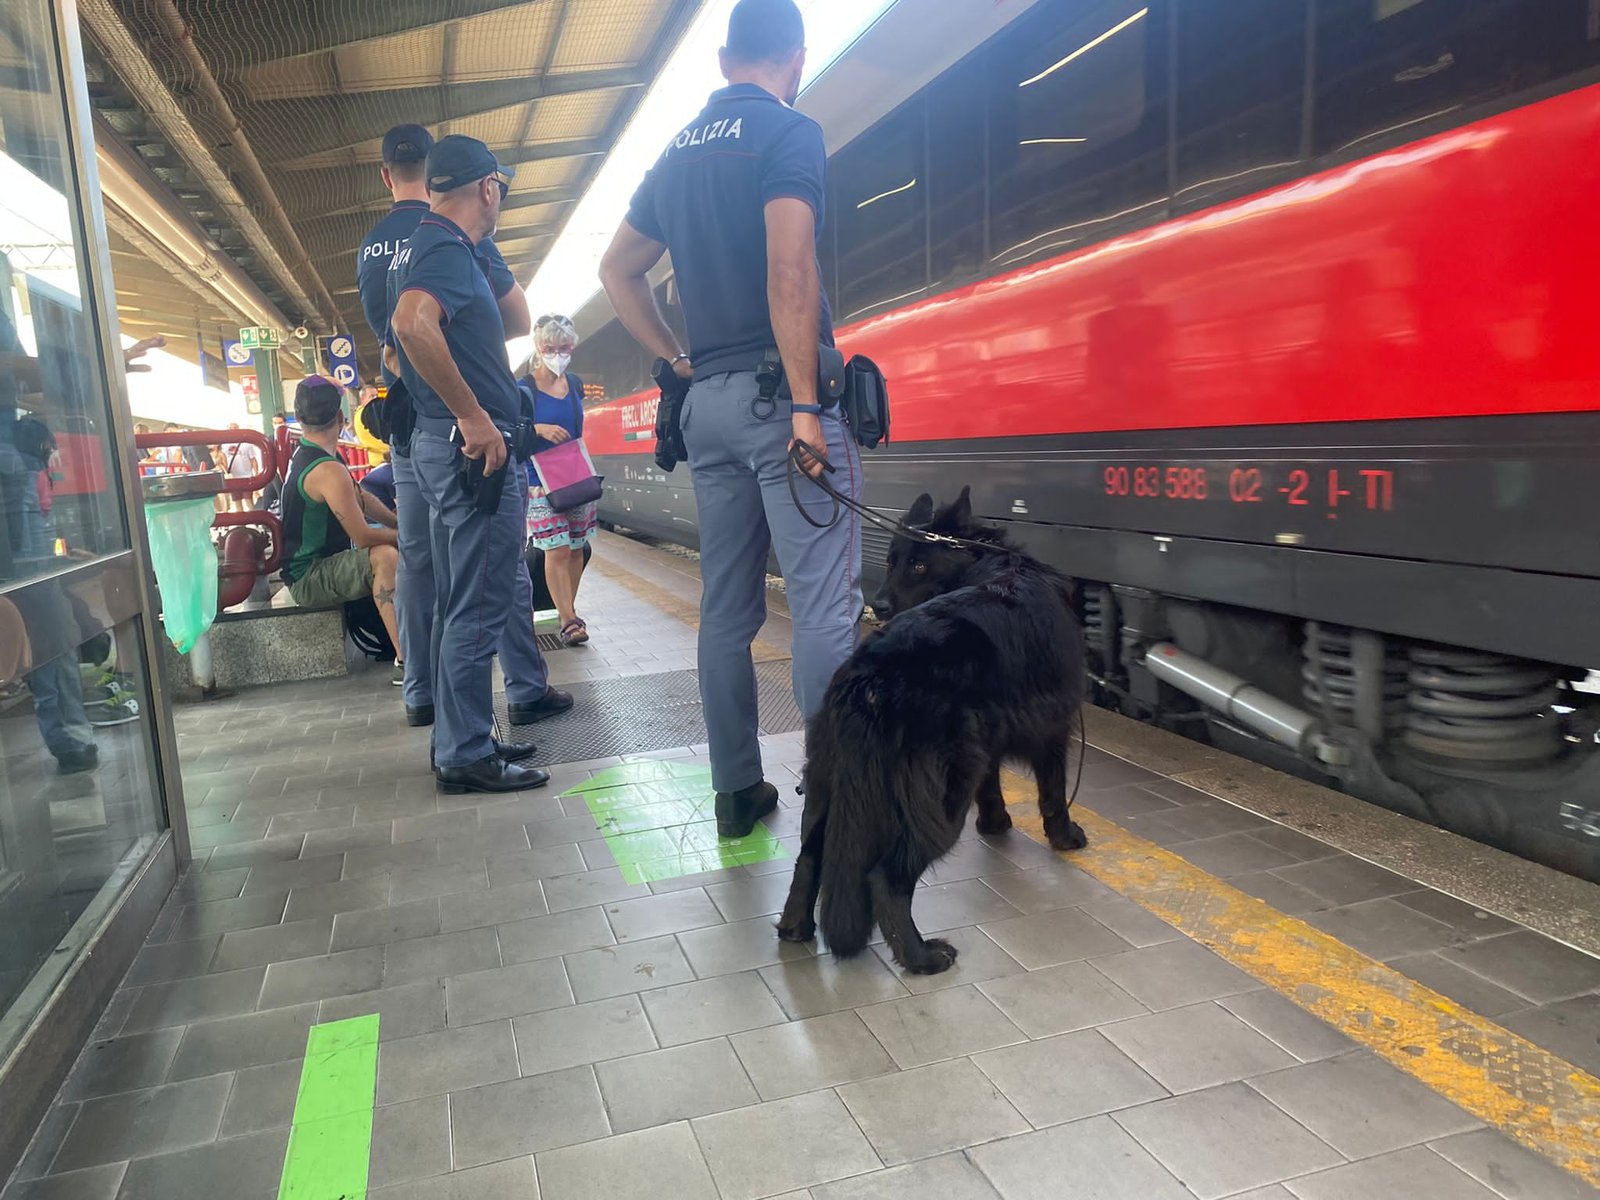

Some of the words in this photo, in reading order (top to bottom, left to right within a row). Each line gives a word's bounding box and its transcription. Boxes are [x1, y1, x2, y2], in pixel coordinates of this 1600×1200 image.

[363, 238, 409, 262] POLI
[1104, 466, 1129, 496] 90
[1134, 466, 1160, 497] 83
[1229, 467, 1264, 502] 02
